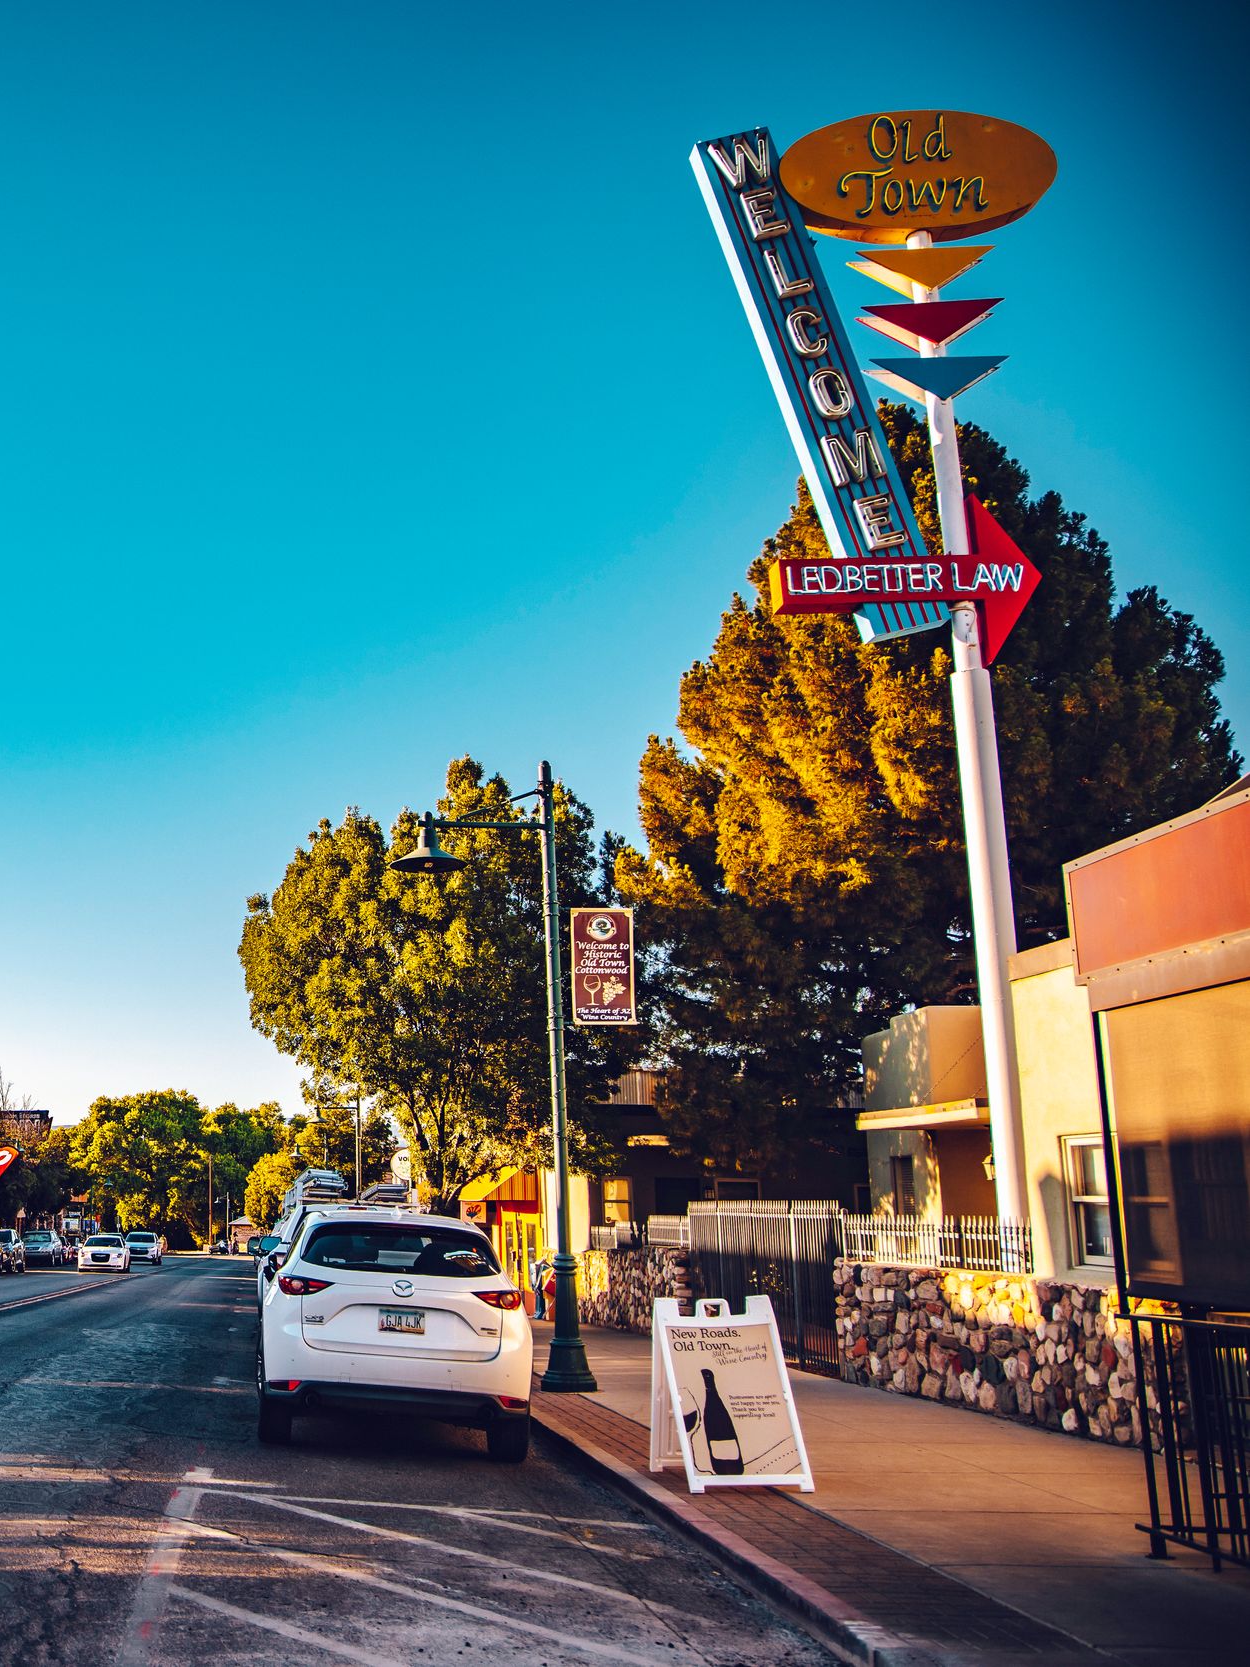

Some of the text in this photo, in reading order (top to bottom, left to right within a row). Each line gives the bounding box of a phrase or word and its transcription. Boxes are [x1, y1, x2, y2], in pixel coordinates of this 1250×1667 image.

[868, 112, 952, 164] Old
[837, 166, 989, 218] Town
[707, 132, 908, 551] WELCOME
[786, 562, 1024, 595] LEDBETTER LAW
[575, 941, 630, 950] Welcome to
[583, 950, 622, 959] Historic
[580, 958, 626, 967] Old Town
[575, 966, 630, 975] Cottonwood
[612, 1007, 620, 1016] of
[671, 1328, 741, 1339] New Roads.
[673, 1341, 735, 1351] Old Town.
[717, 1352, 767, 1366] Wine Country
